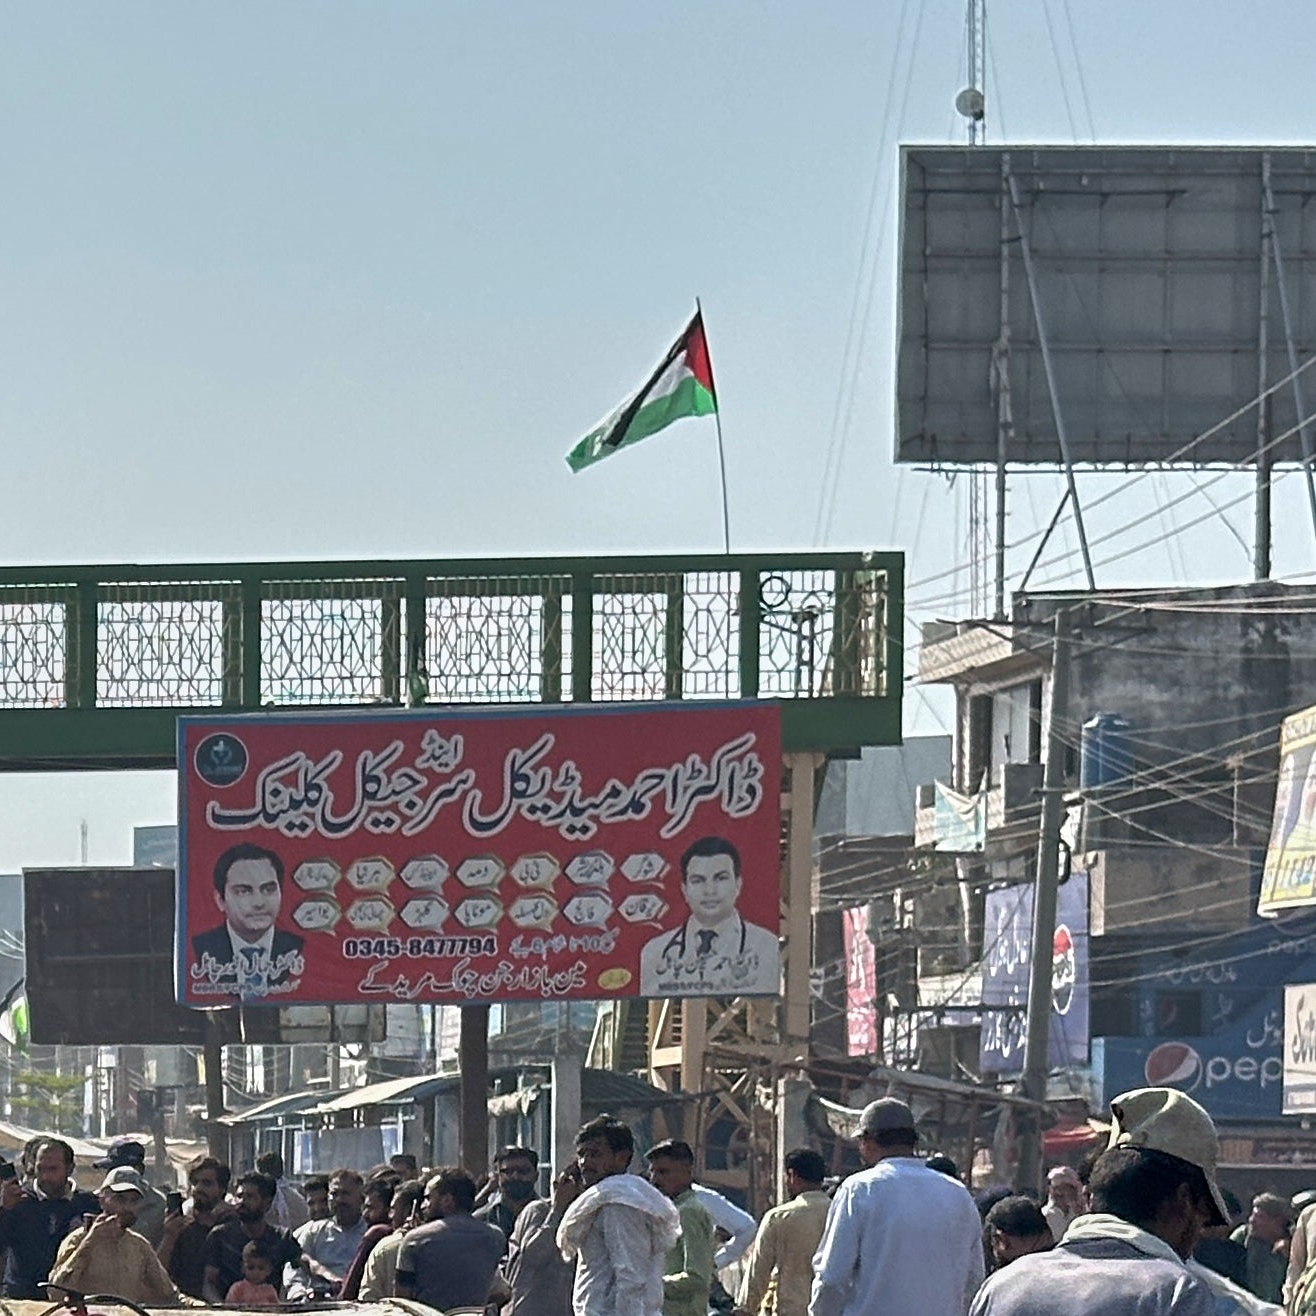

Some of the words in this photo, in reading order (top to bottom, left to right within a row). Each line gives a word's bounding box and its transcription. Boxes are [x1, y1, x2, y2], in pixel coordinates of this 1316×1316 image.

[206, 750, 344, 838] کلینک
[318, 740, 476, 840] سرجیکل
[463, 733, 624, 840] میڈیکل
[600, 764, 683, 823] احمد
[661, 733, 764, 838] ڈاکٹر
[343, 936, 497, 957] 0345-8477794
[1205, 1057, 1283, 1088] pep
